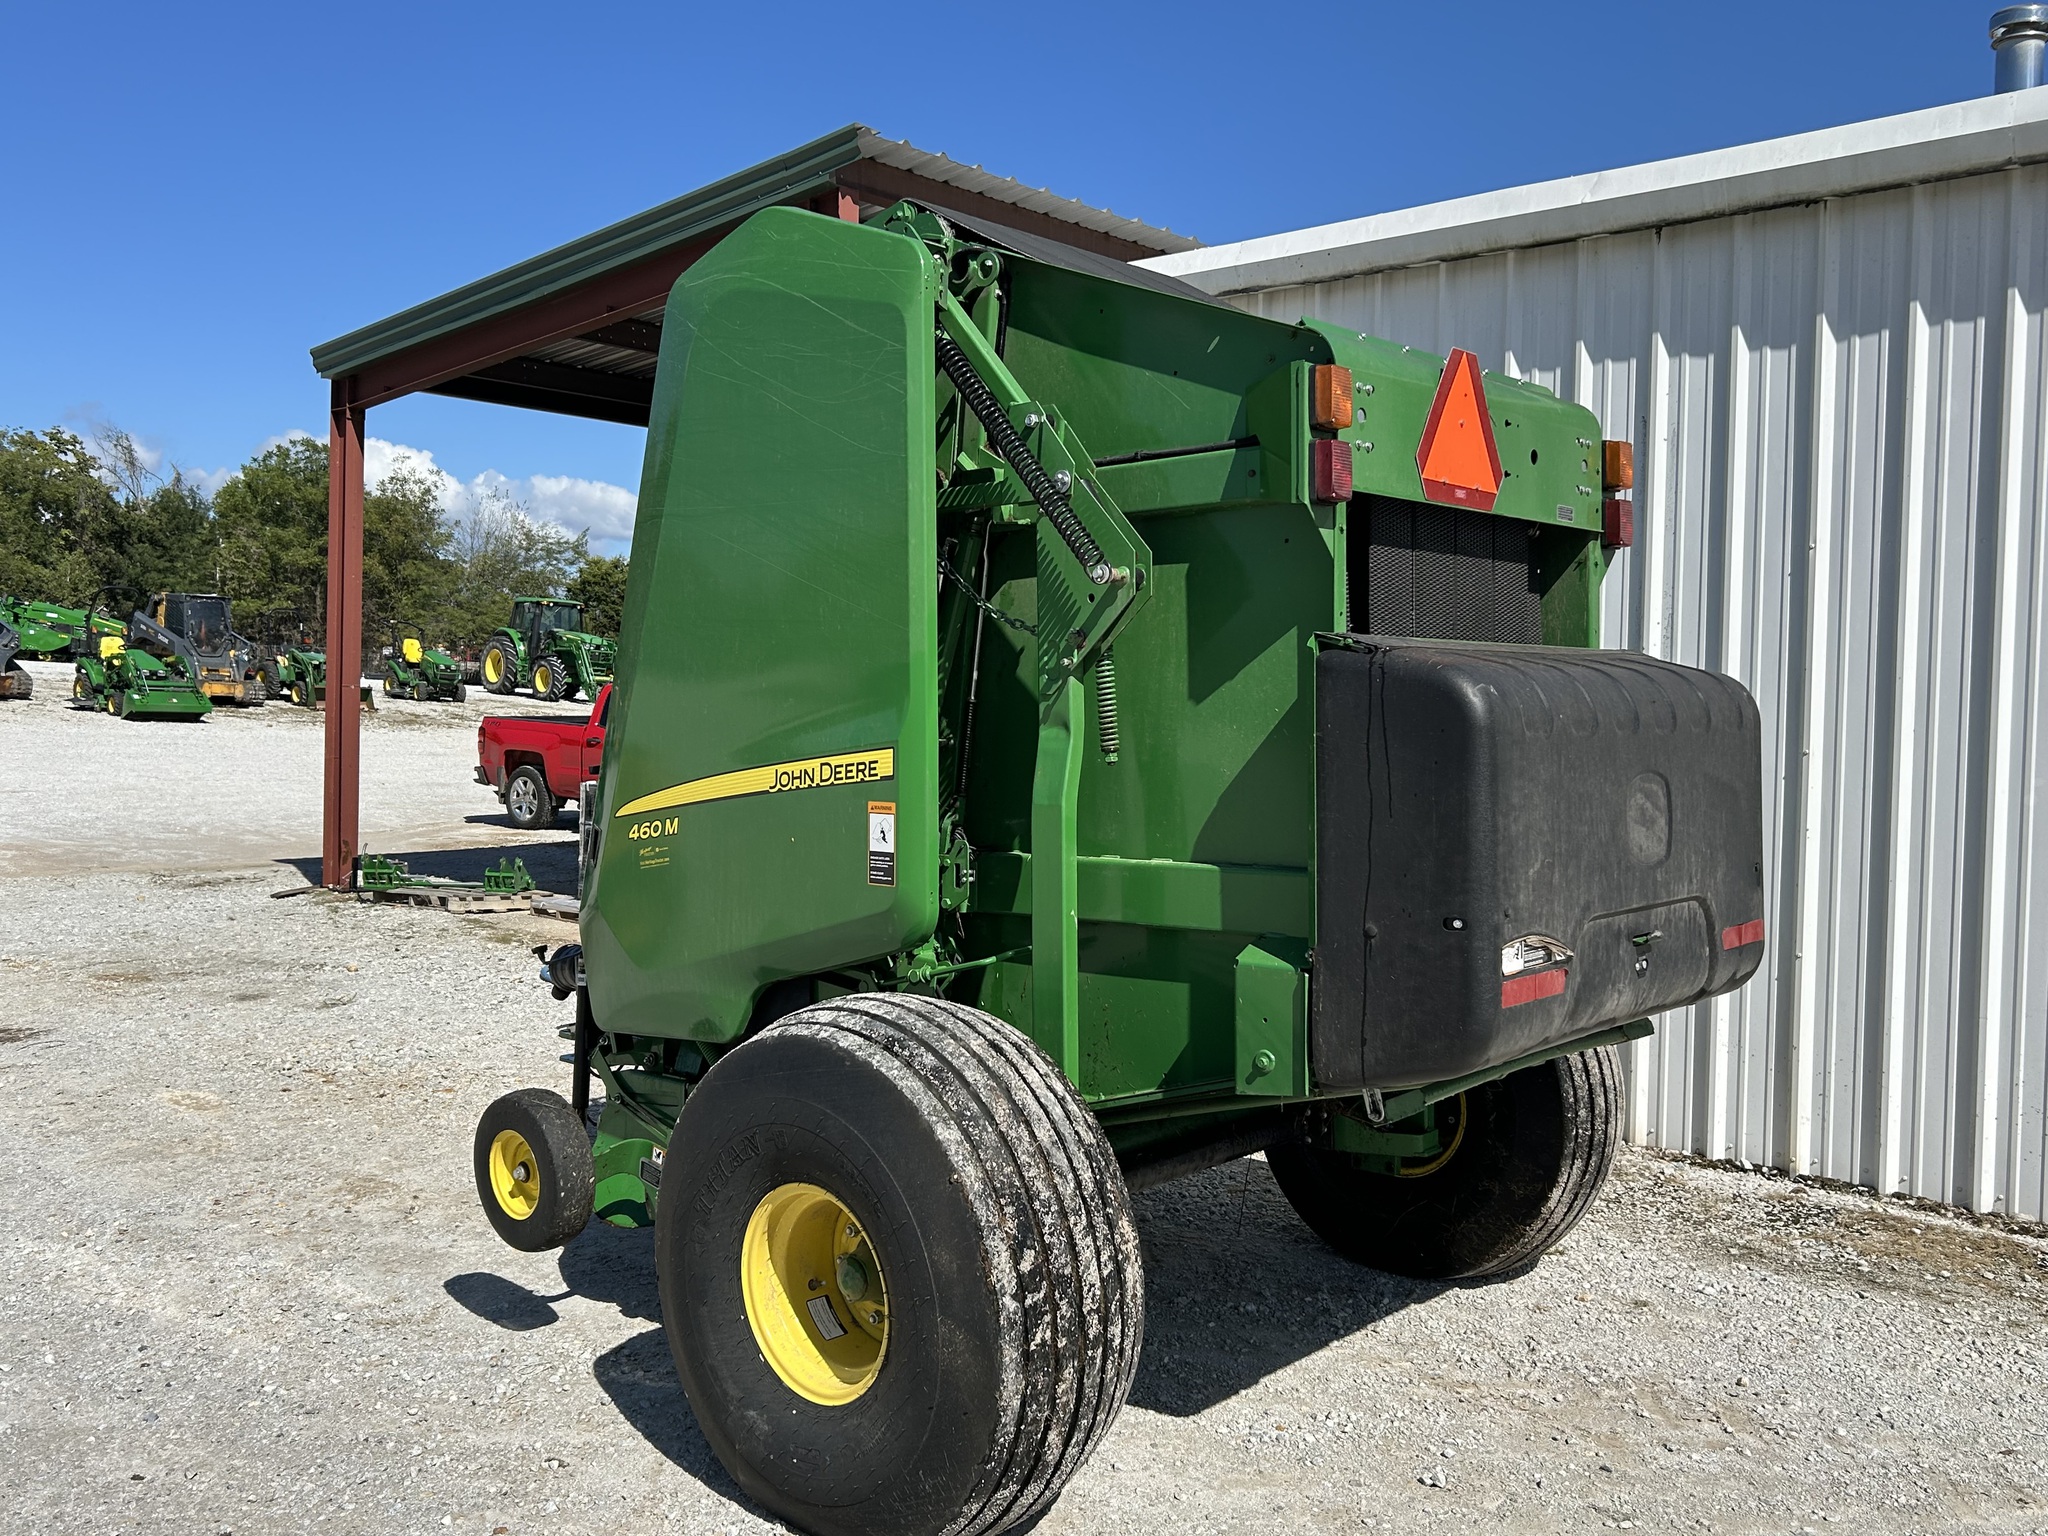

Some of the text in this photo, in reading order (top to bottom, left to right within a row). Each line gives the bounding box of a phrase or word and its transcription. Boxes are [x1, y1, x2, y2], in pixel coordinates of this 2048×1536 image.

[768, 760, 879, 790] JOHN DEERE
[628, 816, 680, 841] 460 M
